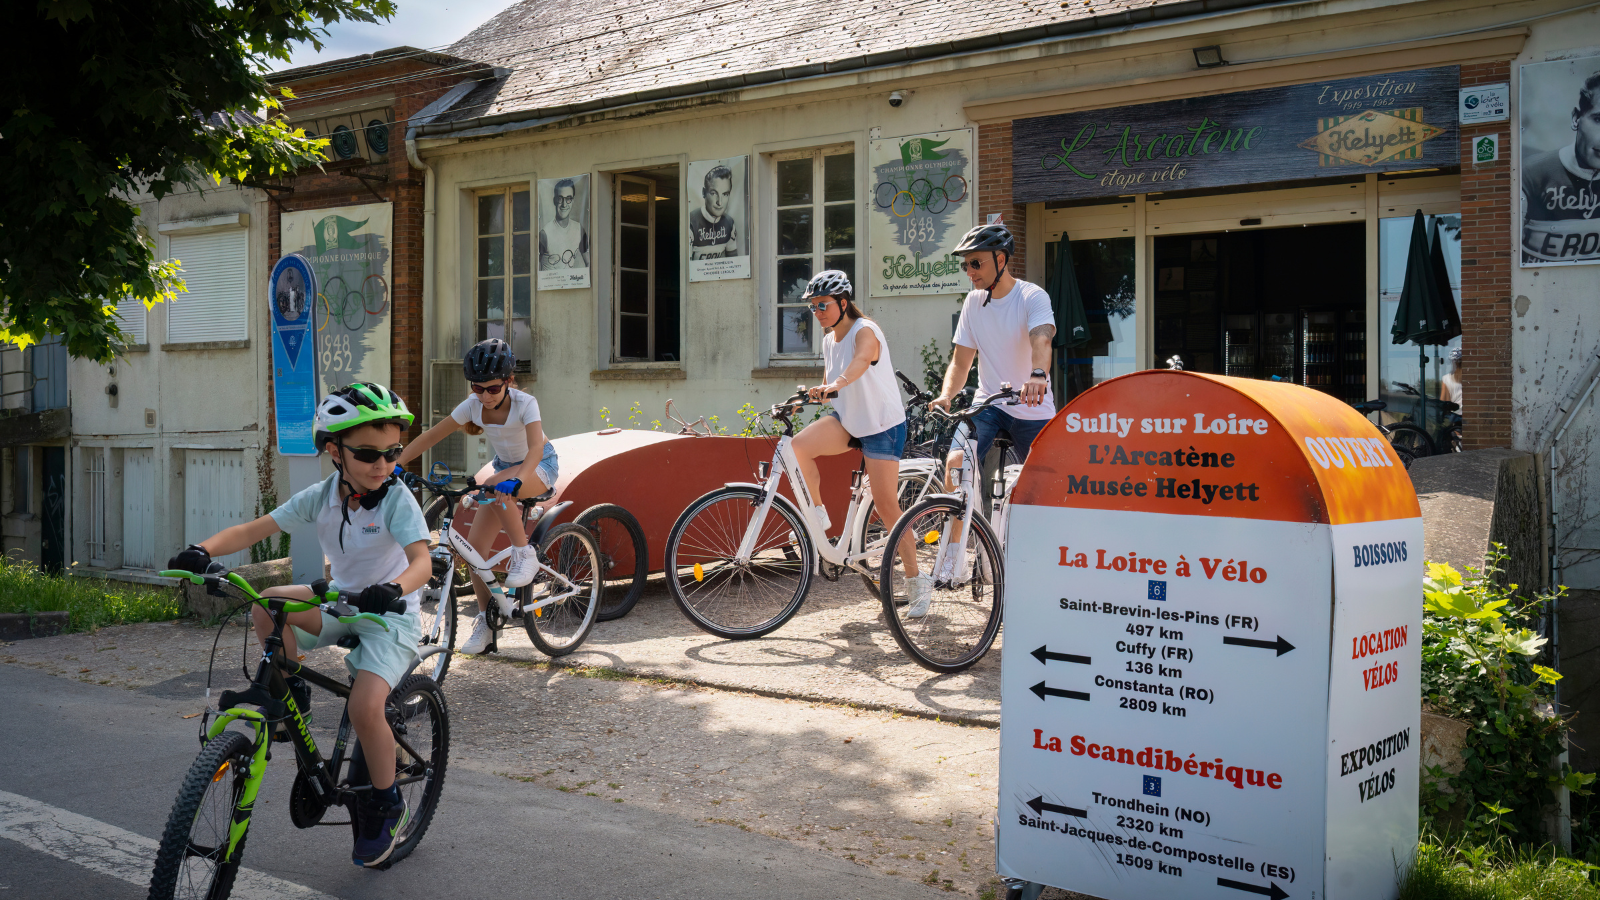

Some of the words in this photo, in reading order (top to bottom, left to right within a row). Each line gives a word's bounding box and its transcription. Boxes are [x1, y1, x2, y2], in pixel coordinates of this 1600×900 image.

[1317, 78, 1417, 106] Exposition
[1342, 102, 1362, 111] 1919
[1373, 97, 1395, 108] 1962
[1041, 116, 1264, 179] L'Arcatène
[1328, 126, 1416, 155] Helyett
[880, 163, 923, 174] CHAMPIONNE
[924, 159, 962, 170] OLYMPIQUE
[1151, 162, 1187, 182] vélo
[1546, 186, 1600, 219] Hely
[698, 226, 727, 245] Helyett
[903, 228, 936, 244] 1952
[906, 216, 933, 231] 1948
[306, 254, 339, 264] MPIONNE
[340, 252, 382, 262] OLYMPIQUE
[883, 252, 960, 283] Helyett
[321, 334, 351, 354] 1948
[319, 351, 353, 372] 1952
[1066, 413, 1134, 438] Sully
[1141, 418, 1187, 433] sur
[1193, 413, 1268, 435] Loire
[1089, 445, 1235, 468] L'Arcatène
[1304, 437, 1393, 469] OUVERT
[1067, 475, 1147, 497] Musée
[1154, 478, 1259, 504] Helyett
[1058, 546, 1088, 568] La
[1096, 549, 1167, 575] Loire
[1176, 555, 1191, 577] à
[1199, 557, 1267, 583] Vélo
[1353, 541, 1407, 567] BOISSONS
[1153, 584, 1161, 596] 6
[1060, 598, 1219, 625] Saint-Brevin-les-Pins
[1225, 614, 1258, 632] (FR)
[1126, 623, 1154, 637] 497
[1160, 626, 1183, 640] km
[1352, 625, 1407, 659] LOCATION
[1116, 641, 1156, 659] Cuffy
[1162, 645, 1193, 663] (FR)
[1126, 661, 1153, 674] 136
[1159, 664, 1182, 678] km
[1363, 661, 1398, 691] VÉLOS
[1095, 675, 1174, 696] Constanta
[1180, 686, 1214, 704] (RO)
[1120, 697, 1157, 712] 2809
[1163, 702, 1186, 717] km
[1033, 729, 1062, 752] La
[1070, 735, 1282, 789] Scandibérique
[1341, 727, 1410, 777] EXPOSITION
[1148, 781, 1156, 791] 3
[1359, 768, 1395, 803] VÉLOS
[1092, 792, 1169, 817] Trondhein
[1175, 807, 1210, 827] (NO)
[1117, 815, 1154, 833] 2320
[1160, 823, 1183, 838] km
[1019, 813, 1254, 872] Saint-Jacques-de-Compostelle
[1261, 862, 1295, 883] (ES)
[1116, 853, 1153, 870] 1509
[1159, 861, 1182, 877] km
